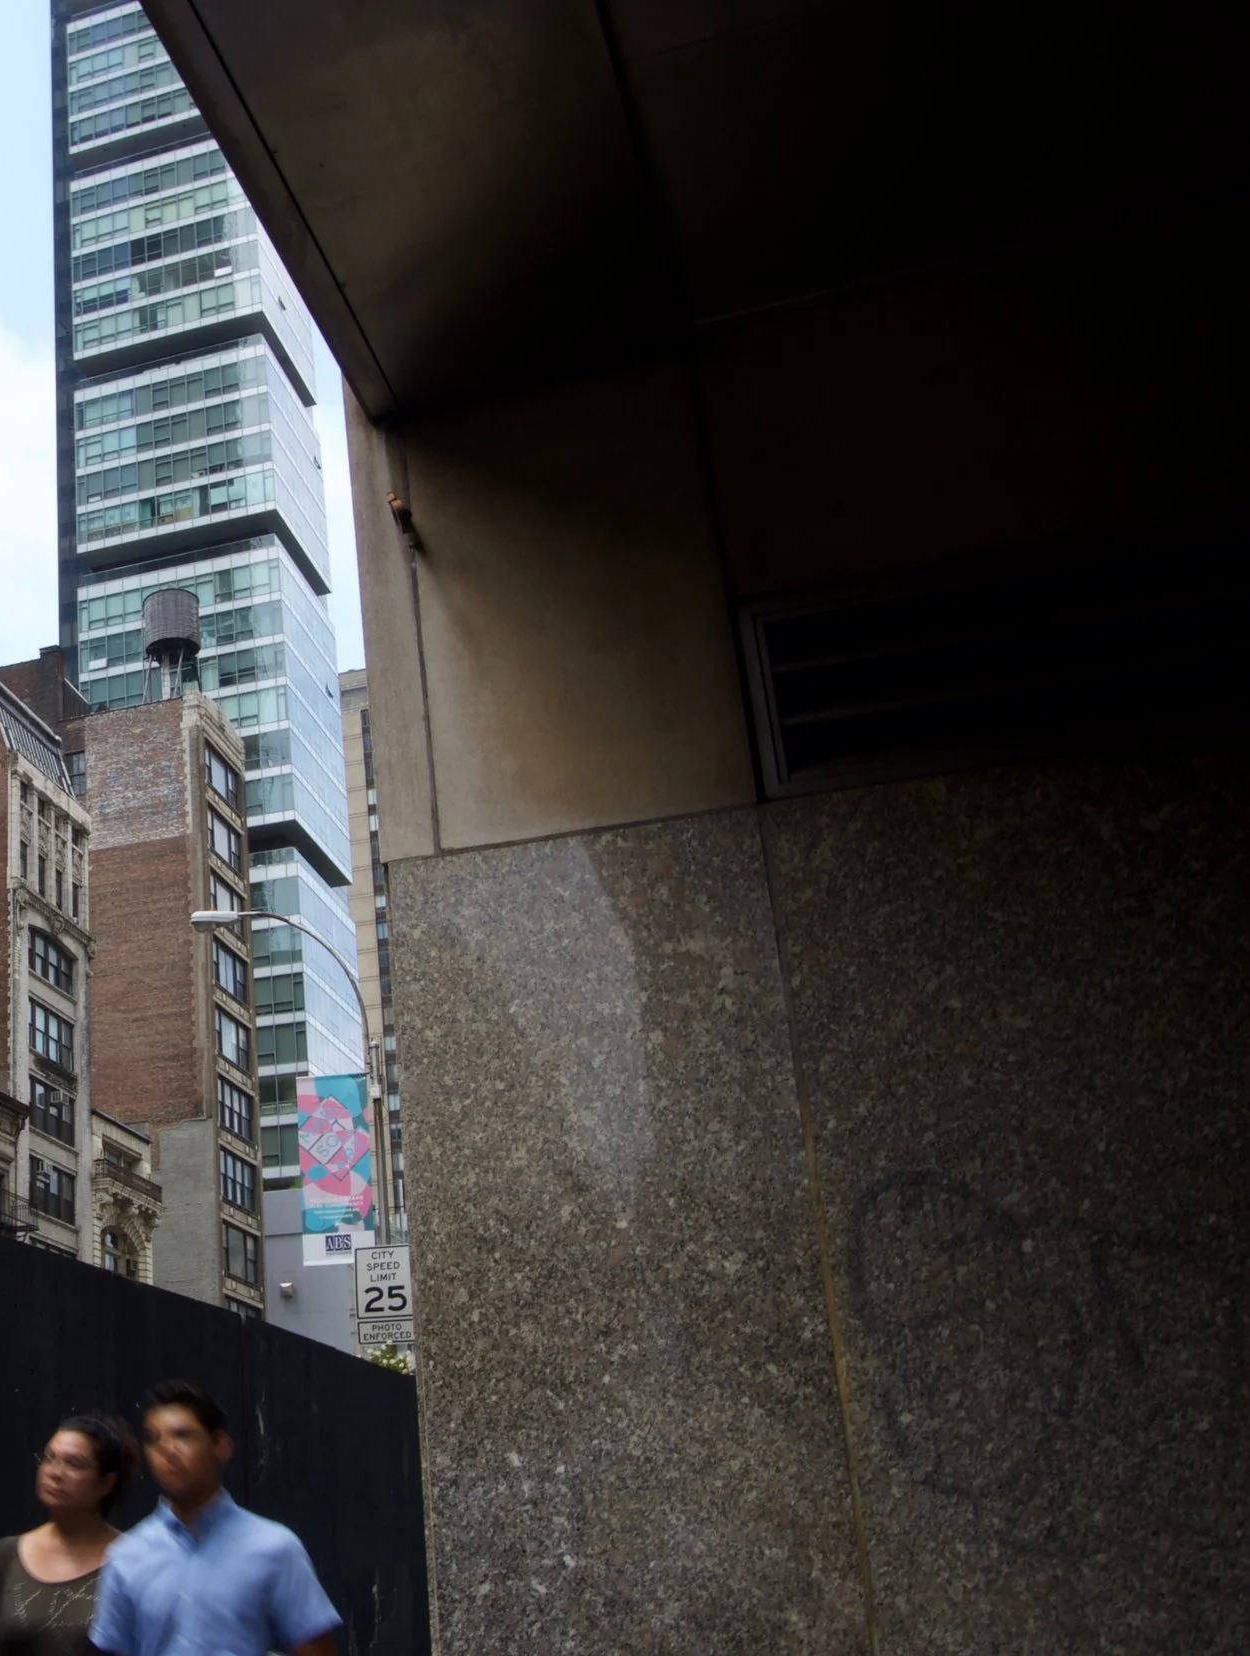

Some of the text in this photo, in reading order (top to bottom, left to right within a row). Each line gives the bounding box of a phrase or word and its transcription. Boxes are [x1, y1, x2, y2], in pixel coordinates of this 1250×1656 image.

[326, 1234, 352, 1251] ABS
[371, 1250, 395, 1260] CITY
[366, 1261, 401, 1272] SPEED
[370, 1272, 397, 1283] LIMIT
[364, 1284, 408, 1313] 25
[371, 1323, 403, 1332] PHOTO
[363, 1331, 412, 1341] ENFORCED
